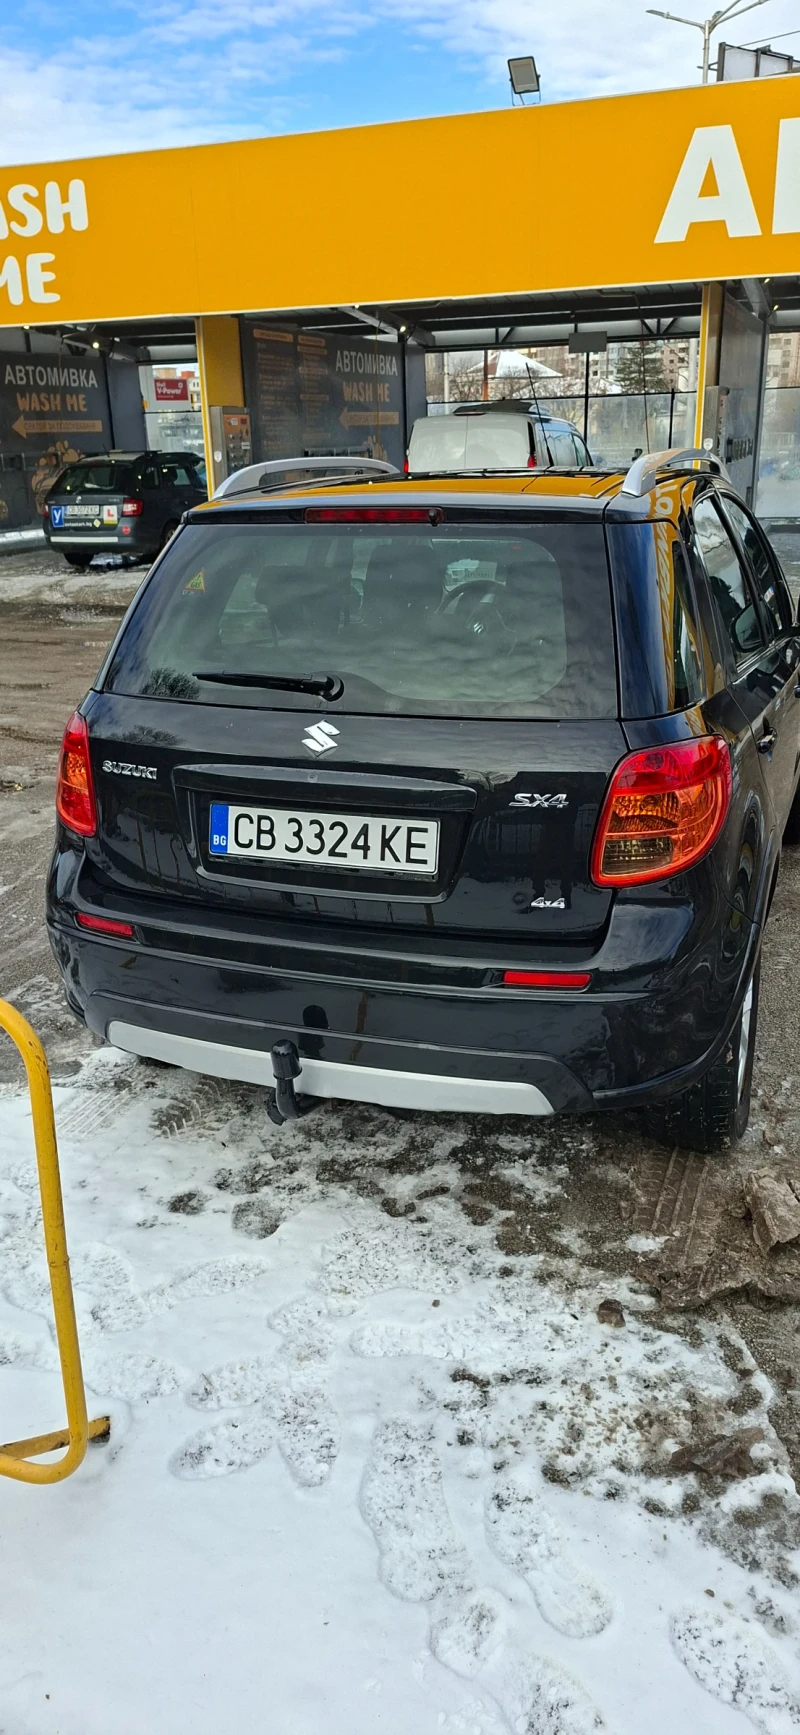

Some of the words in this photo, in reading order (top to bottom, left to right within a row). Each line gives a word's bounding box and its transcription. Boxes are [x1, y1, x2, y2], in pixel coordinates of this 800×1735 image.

[0, 179, 88, 239] SH
[335, 349, 398, 377] АВТОМИВКА
[4, 364, 98, 388] АВТОМИВКА
[16, 392, 61, 412] WASH
[65, 393, 88, 412] ME
[342, 381, 373, 402] WASH
[377, 383, 390, 403] ME
[107, 508, 114, 518] L
[102, 760, 157, 780] SUZUKI
[508, 793, 569, 809] SX4
[213, 834, 227, 846] BG
[234, 813, 276, 851] CB
[284, 817, 371, 860] 3324
[379, 824, 429, 865] KE
[531, 897, 566, 909] 4x4
